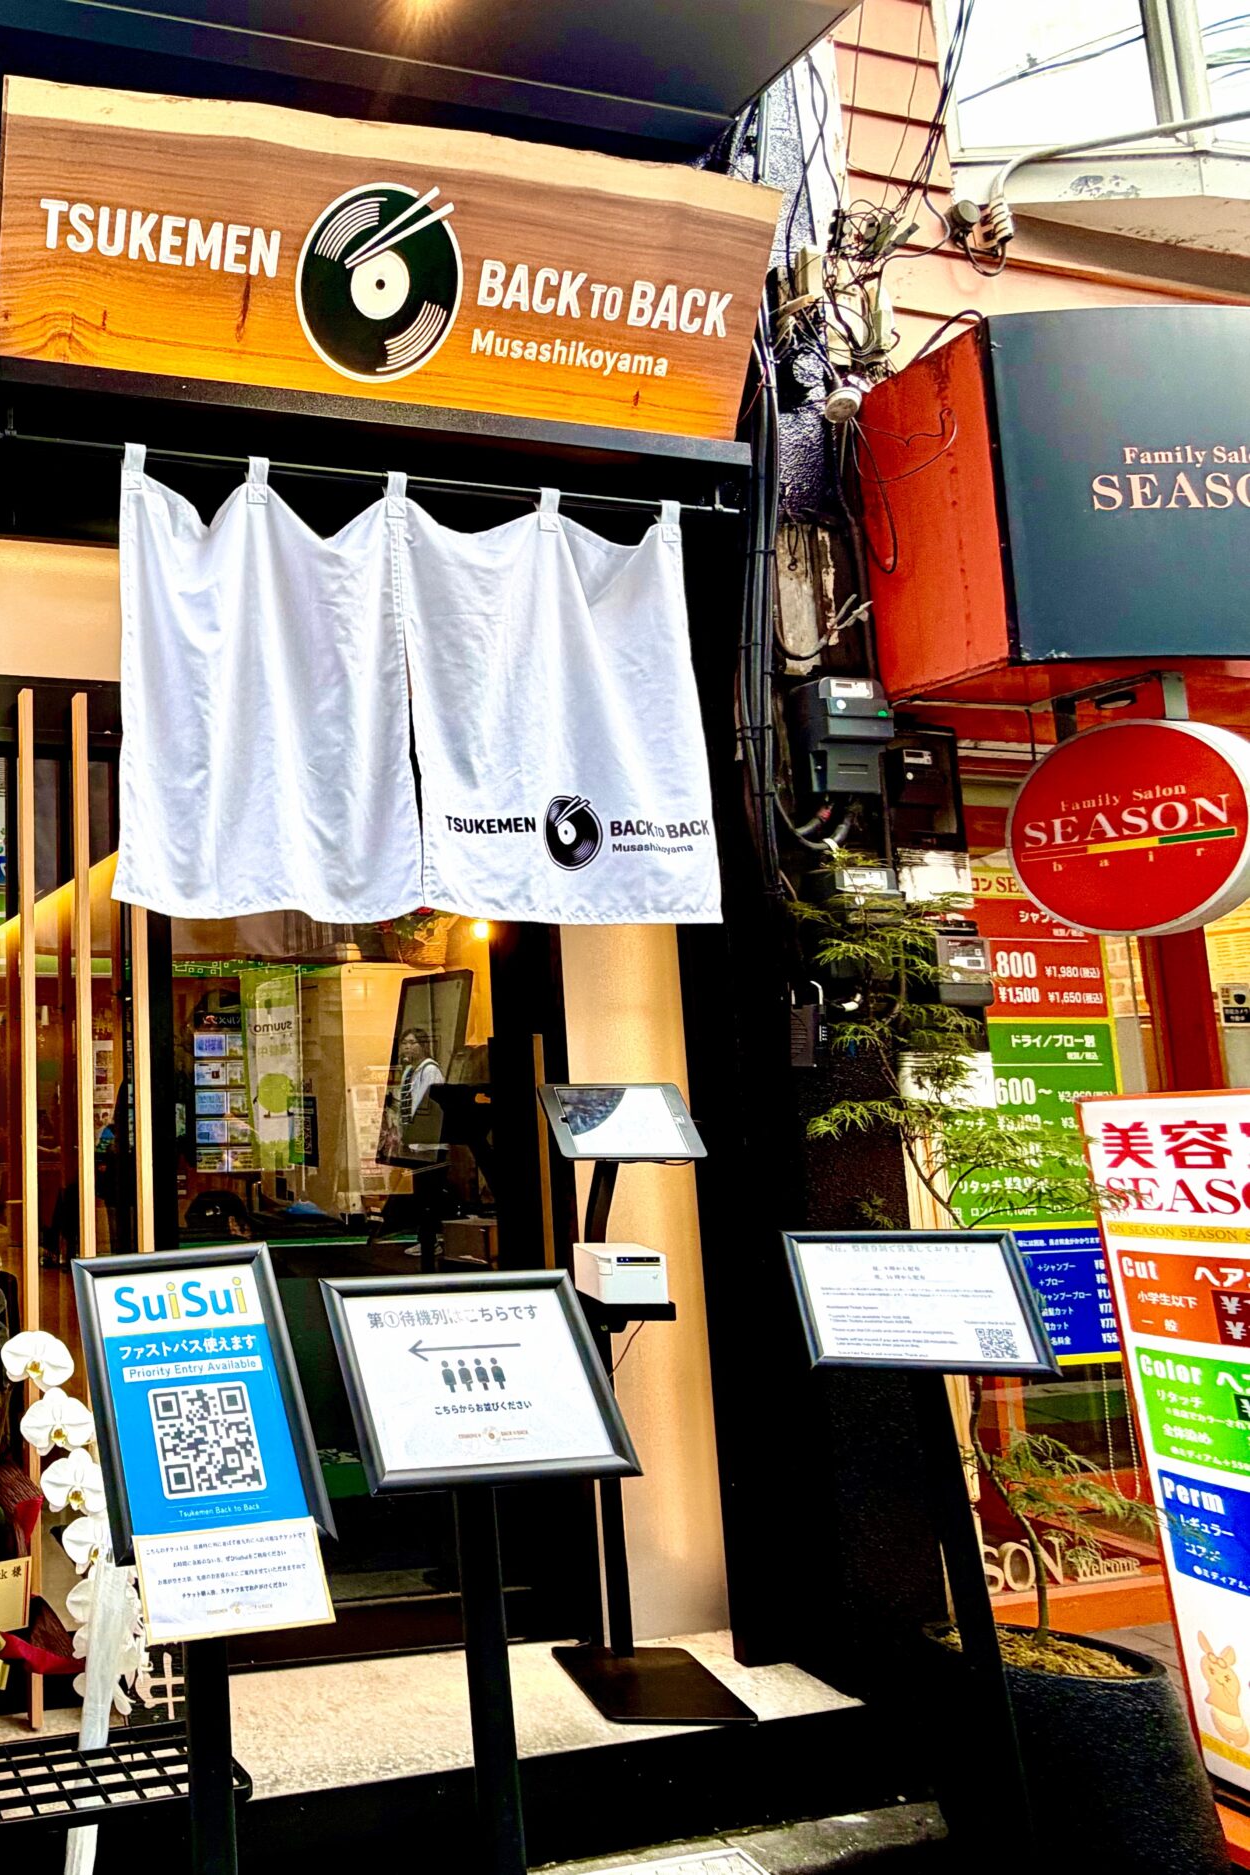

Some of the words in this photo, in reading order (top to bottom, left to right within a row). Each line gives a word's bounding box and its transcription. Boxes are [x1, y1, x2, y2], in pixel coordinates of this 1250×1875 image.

[40, 198, 281, 278] TSUKEMEN
[477, 259, 582, 318] BACK
[590, 284, 623, 321] TO
[627, 280, 733, 338] BACK
[470, 328, 669, 377] Musashikoyama
[1122, 445, 1206, 468] Family
[1060, 793, 1120, 812] Family
[1132, 785, 1186, 801] Salon
[446, 815, 537, 834] TSUKEMEN
[610, 820, 653, 837] BACK
[668, 820, 710, 839] BACK
[1023, 793, 1230, 848] SEASON
[612, 842, 694, 854] Musashikoyama
[1019, 910, 1062, 924] シャン
[1102, 1120, 1250, 1170] 美容
[1105, 1177, 1250, 1216] SEAS
[1129, 1225, 1175, 1237] SEASON
[1181, 1228, 1239, 1241] SEASON
[1122, 1256, 1159, 1280] Cut
[1194, 1266, 1250, 1287] ヘア
[114, 1276, 248, 1324] SuiSui
[1137, 1291, 1198, 1309] 小学生以下
[119, 1334, 256, 1360] ファストパス使えます
[129, 1365, 171, 1379] Priority
[175, 1363, 203, 1375] Entry
[207, 1358, 256, 1371] Available
[1139, 1354, 1203, 1386] Color
[434, 1400, 533, 1416] こちらからお並びください
[1162, 1476, 1225, 1515] Perm
[179, 1508, 213, 1518] Tsukemen
[216, 1506, 232, 1514] Back
[243, 1503, 260, 1511] Back
